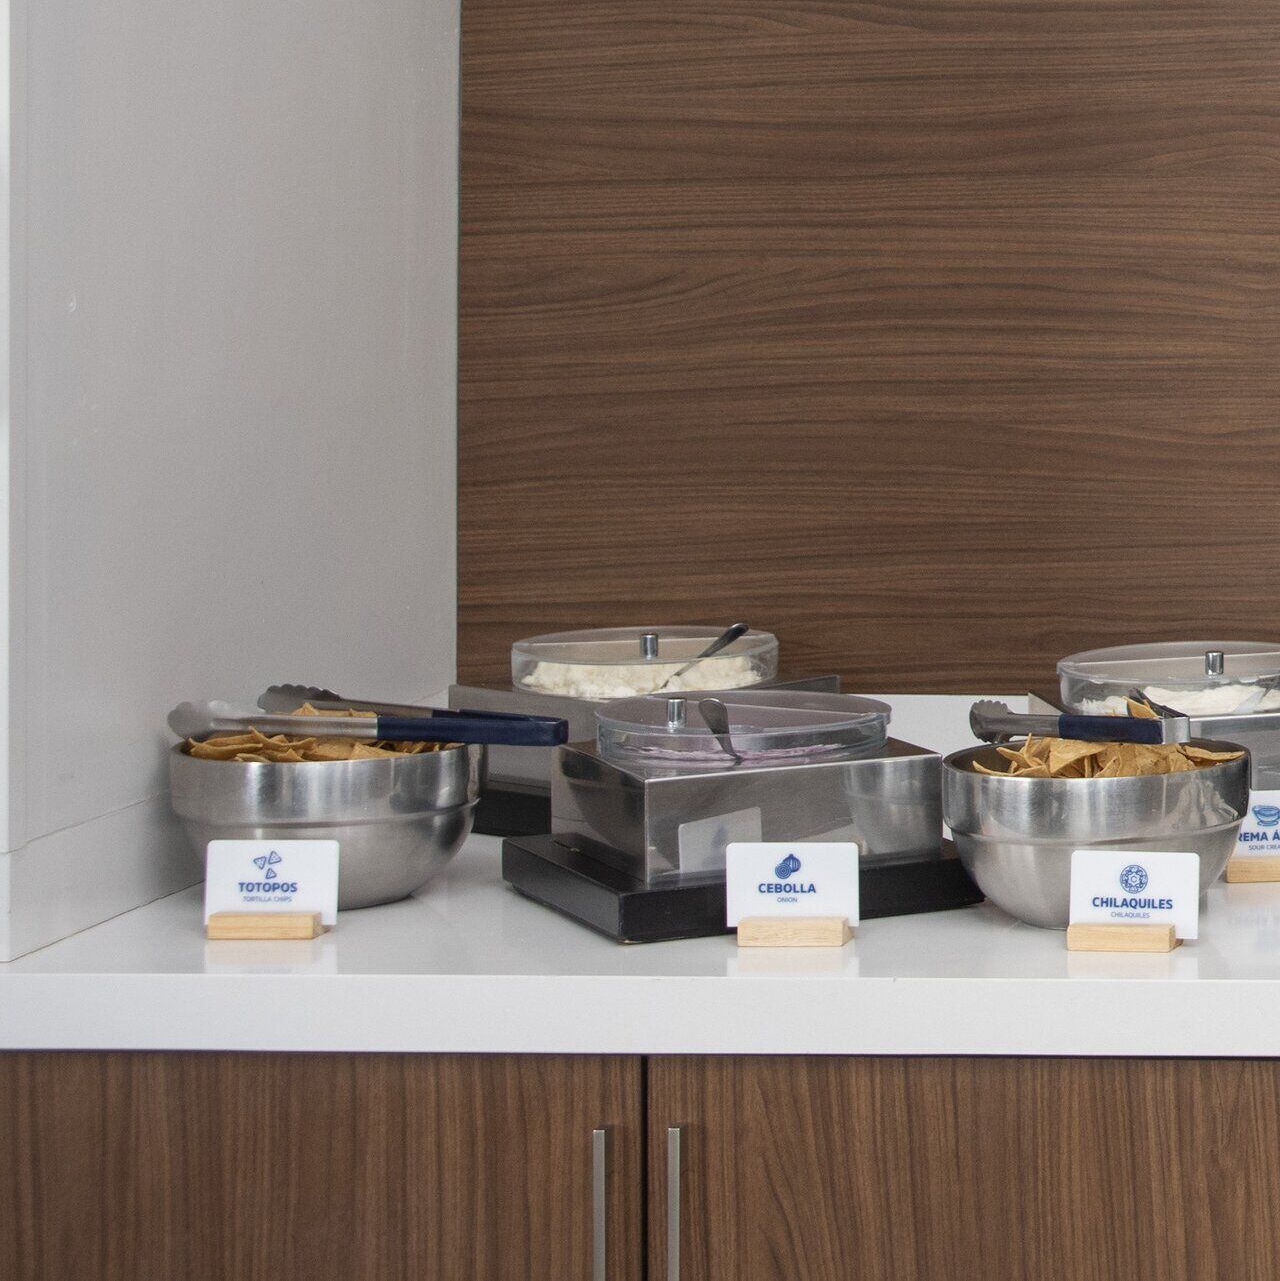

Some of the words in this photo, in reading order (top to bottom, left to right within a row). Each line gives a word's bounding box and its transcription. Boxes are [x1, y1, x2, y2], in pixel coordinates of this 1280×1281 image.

[1238, 831, 1268, 842] REMA
[238, 882, 298, 892] TOTOPOS
[758, 883, 816, 894] CEBOLLA
[1092, 896, 1173, 910] CHILAQUILES
[1110, 911, 1150, 919] CHILAQUILES
